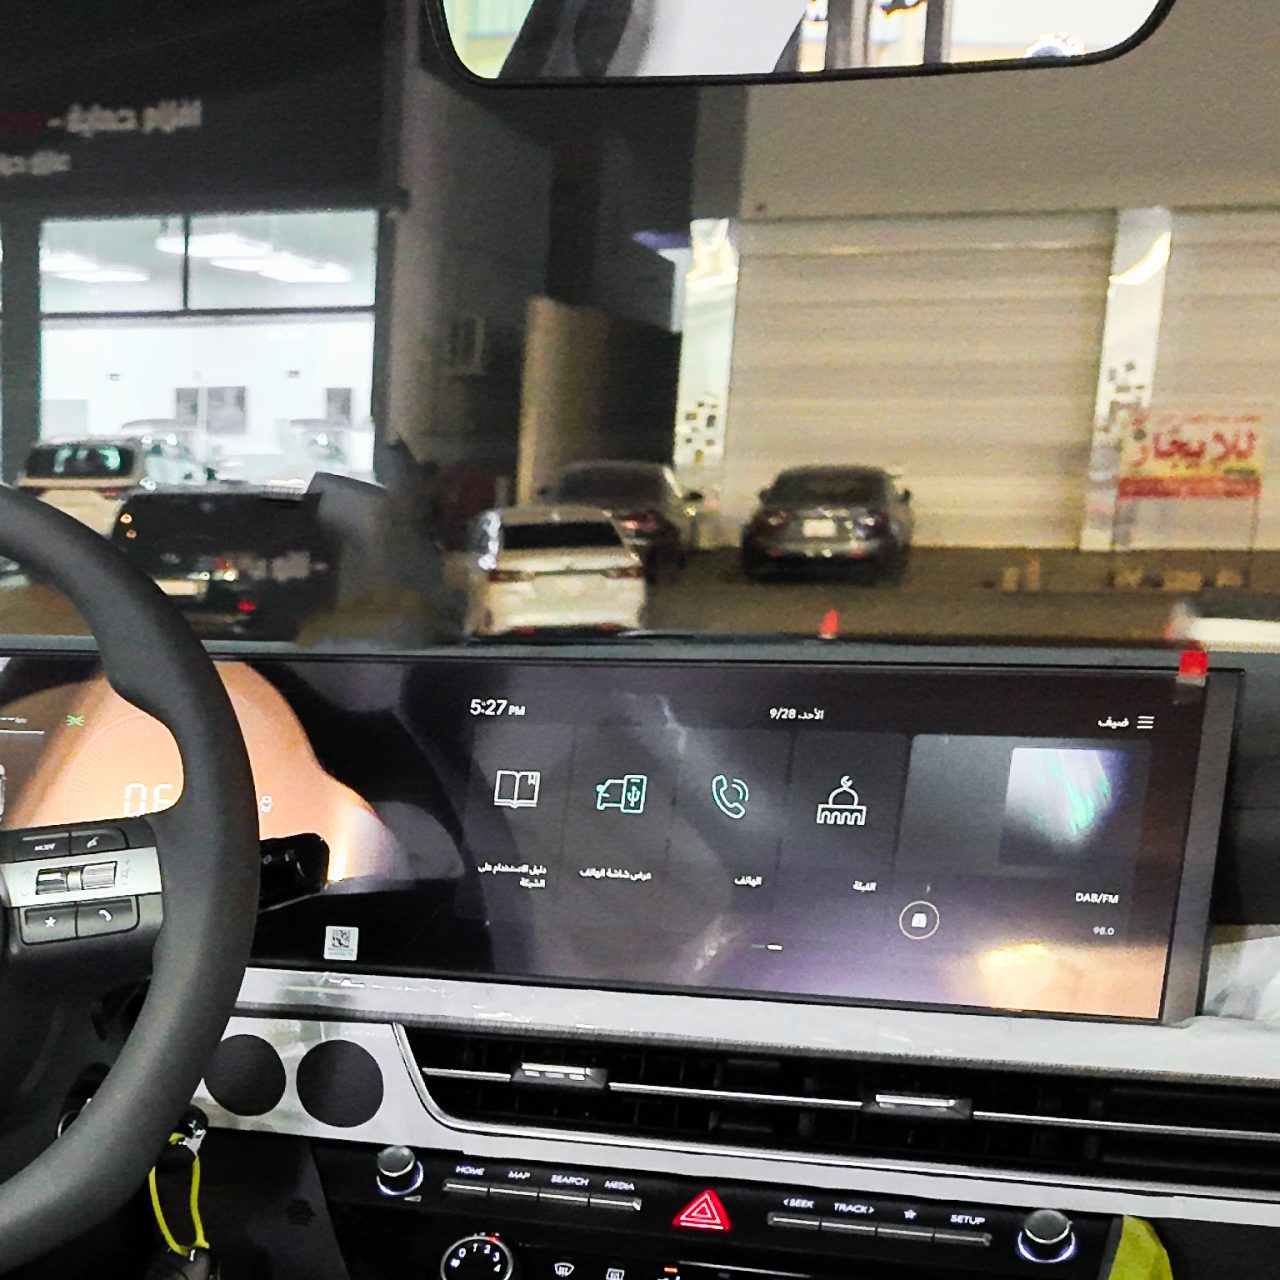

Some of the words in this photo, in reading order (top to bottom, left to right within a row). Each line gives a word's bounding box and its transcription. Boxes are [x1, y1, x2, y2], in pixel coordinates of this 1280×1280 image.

[470, 698, 508, 716] 5:27
[508, 704, 526, 716] PM
[769, 707, 797, 720] 9/28
[1097, 715, 1130, 730] ضيف
[1075, 892, 1119, 904] DAB/FM
[455, 1165, 485, 1176] HOME
[507, 1170, 531, 1180] MAP
[550, 1174, 590, 1186] SEARCH
[604, 1180, 635, 1191] MEDIA
[950, 1214, 986, 1225] SETUP
[458, 1247, 467, 1259] 0
